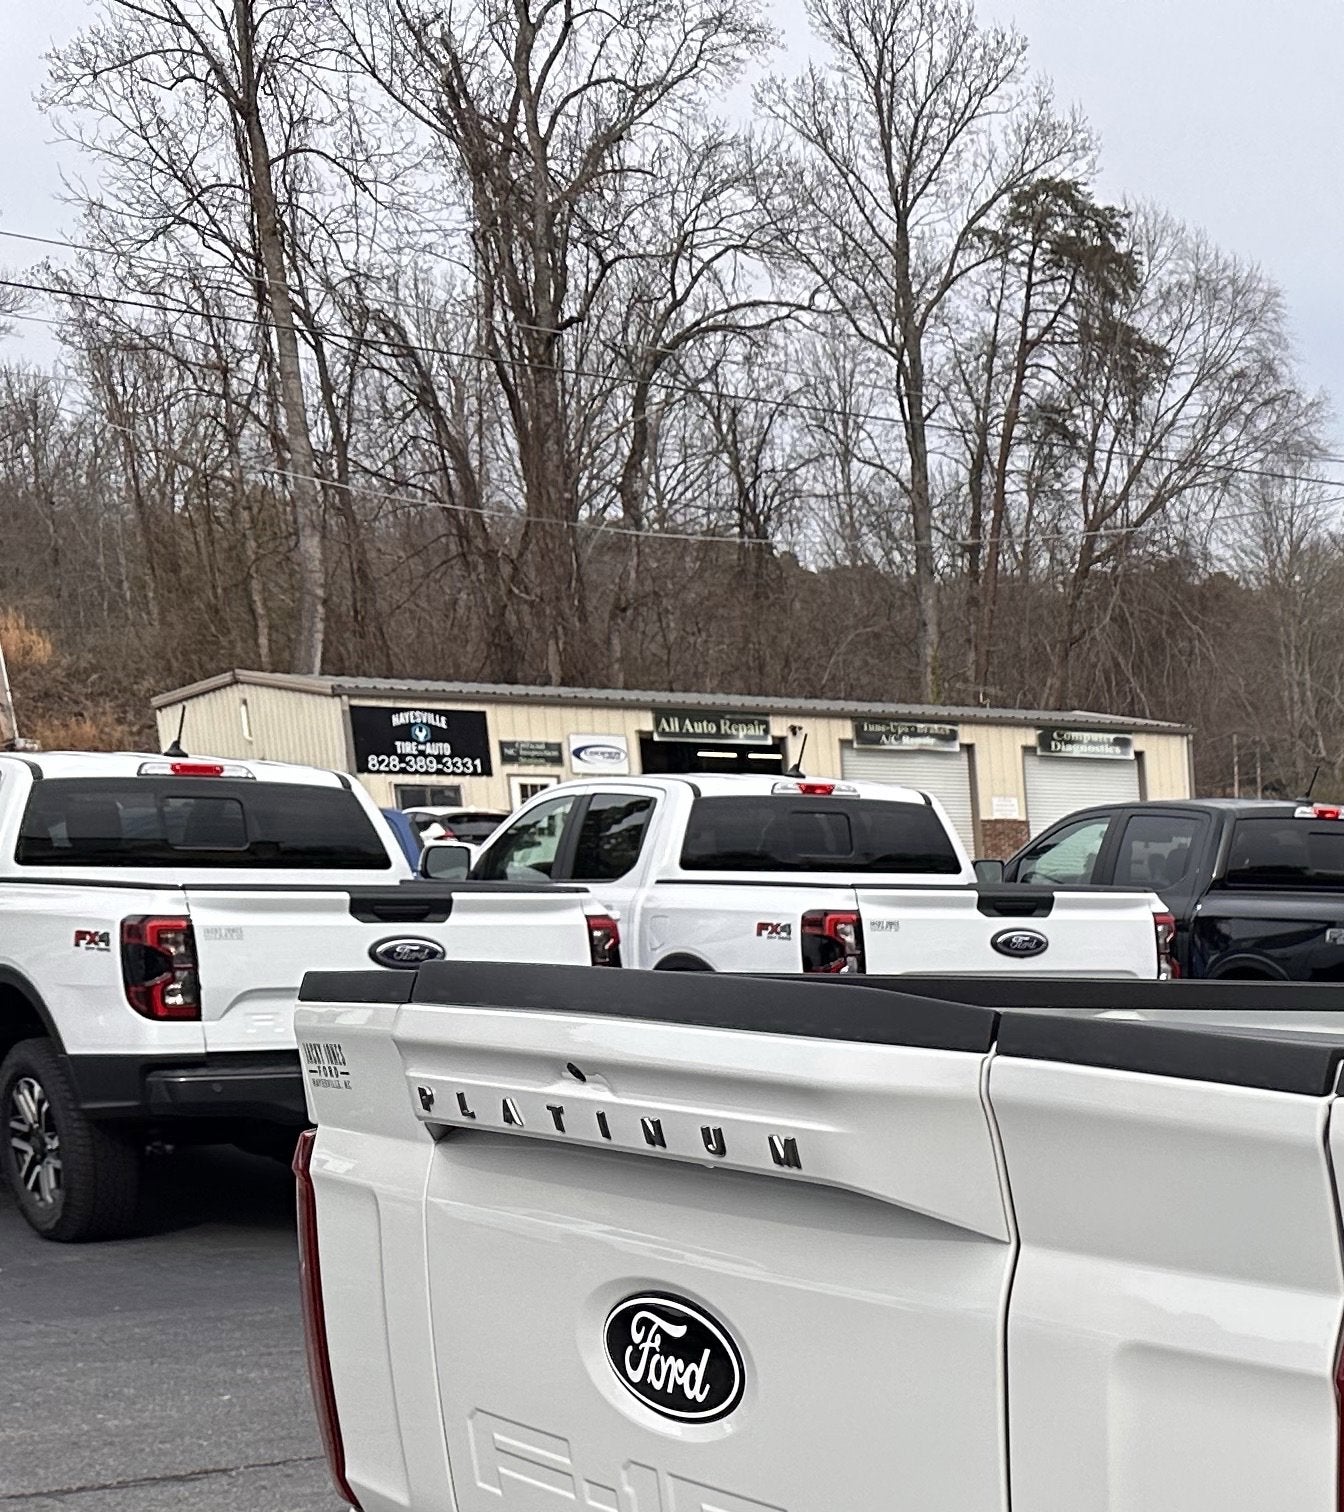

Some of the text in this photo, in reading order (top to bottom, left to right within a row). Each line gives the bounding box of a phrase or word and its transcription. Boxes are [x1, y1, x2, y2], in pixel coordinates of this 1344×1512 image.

[391, 710, 448, 729] HAYESVILLE
[658, 717, 766, 739] All Auto Repair
[394, 741, 418, 755] TIRE
[425, 742, 452, 756] AUTO
[367, 754, 482, 774] 828-389-3331
[74, 930, 111, 947] FX4
[757, 922, 792, 936] FX4
[317, 1066, 339, 1078] FORD
[417, 1085, 802, 1170] PLATINUM
[624, 1310, 711, 1403] Ford
